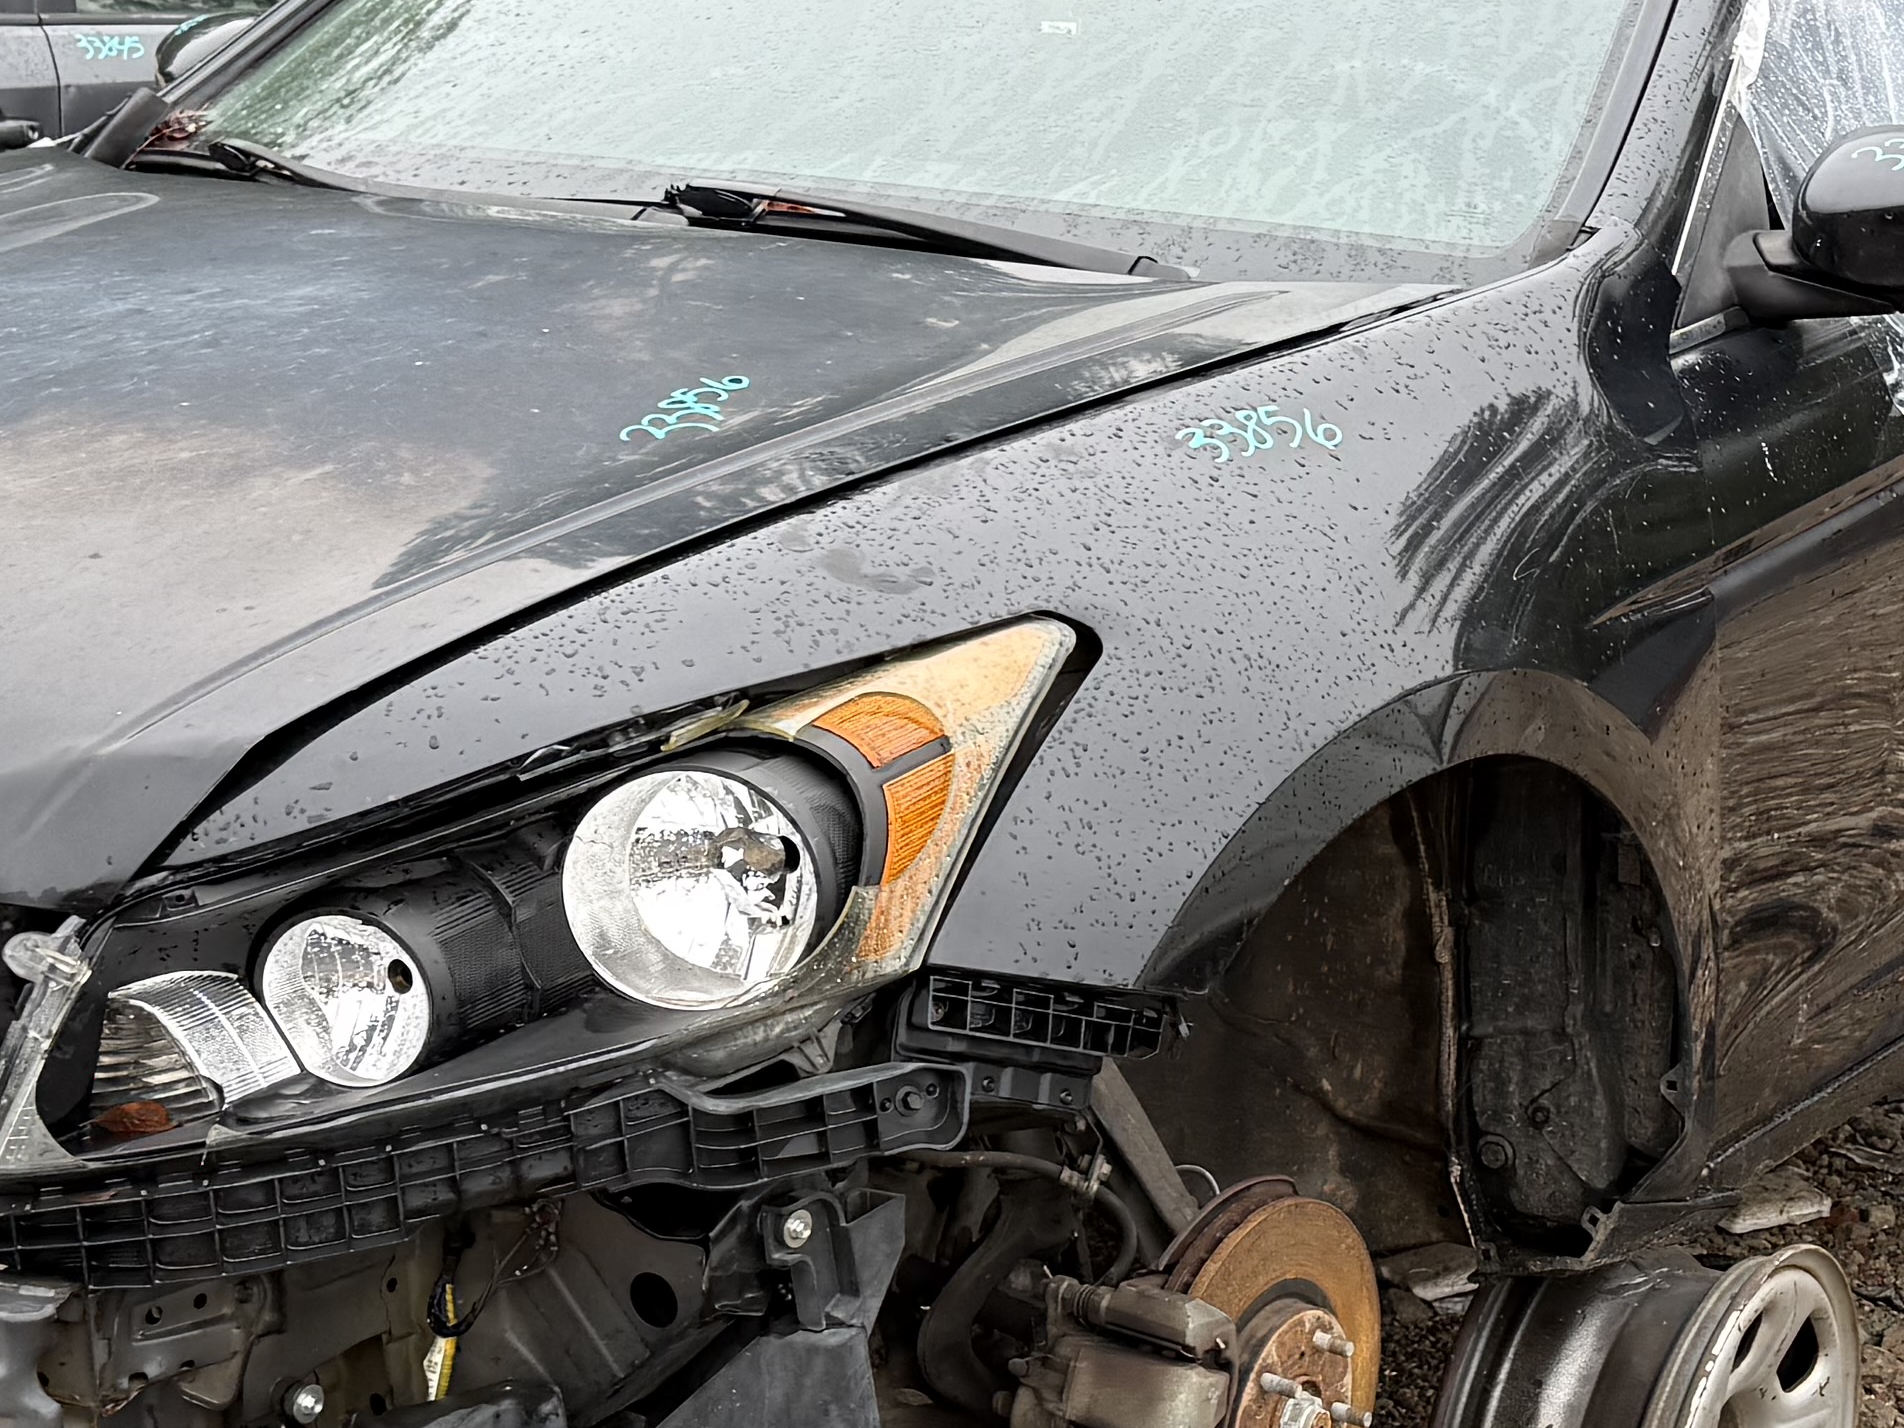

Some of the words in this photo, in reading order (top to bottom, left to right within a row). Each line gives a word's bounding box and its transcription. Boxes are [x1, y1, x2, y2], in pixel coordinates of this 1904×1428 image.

[74, 33, 145, 60] 33845
[619, 375, 750, 441] 33856
[1175, 405, 1343, 464] 33856
